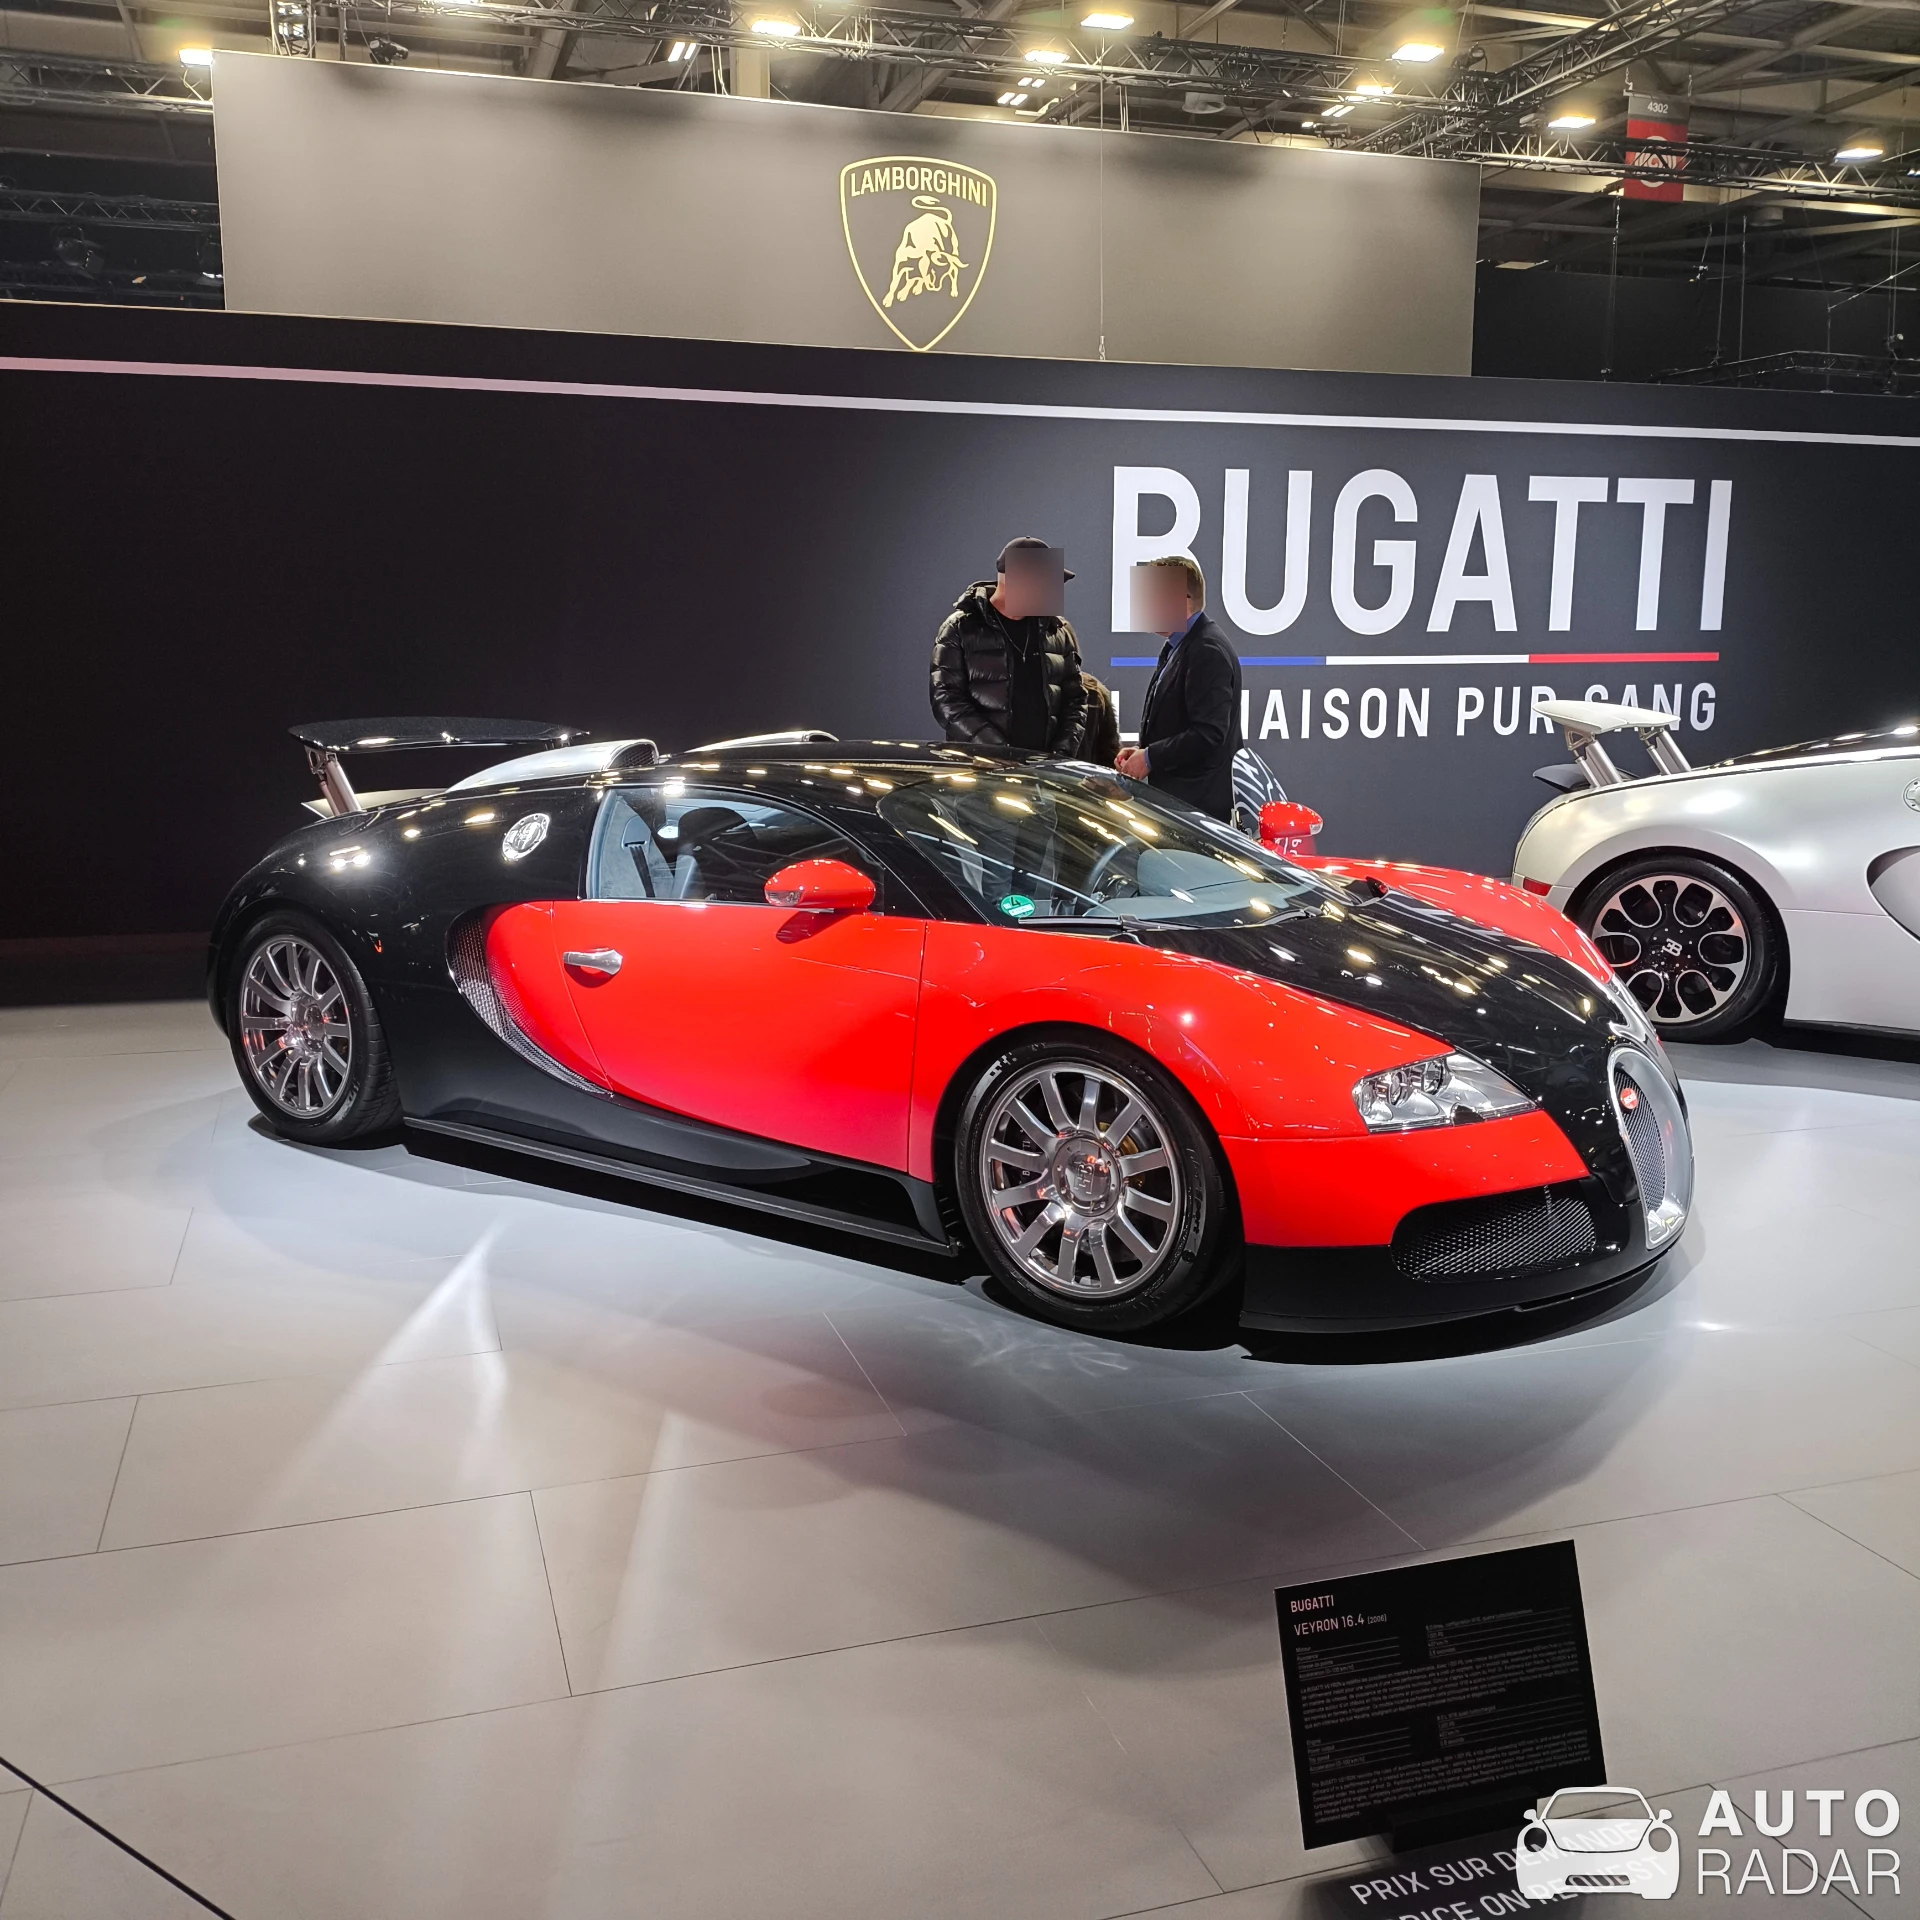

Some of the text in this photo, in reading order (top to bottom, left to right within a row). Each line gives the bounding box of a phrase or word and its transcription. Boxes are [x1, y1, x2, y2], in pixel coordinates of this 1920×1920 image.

[1647, 101, 1669, 114] 4302
[851, 166, 988, 207] LAMBORGHINI
[1240, 687, 1431, 740] AISON
[1456, 686, 1557, 736] PUR
[1290, 1594, 1335, 1613] BUGATTI
[1294, 1617, 1340, 1636] VEYRON
[1341, 1612, 1365, 1629] 16.4
[1350, 1871, 1430, 1905] PRIX
[1429, 1857, 1496, 1886] SUR
[1479, 1889, 1531, 1917] ON
